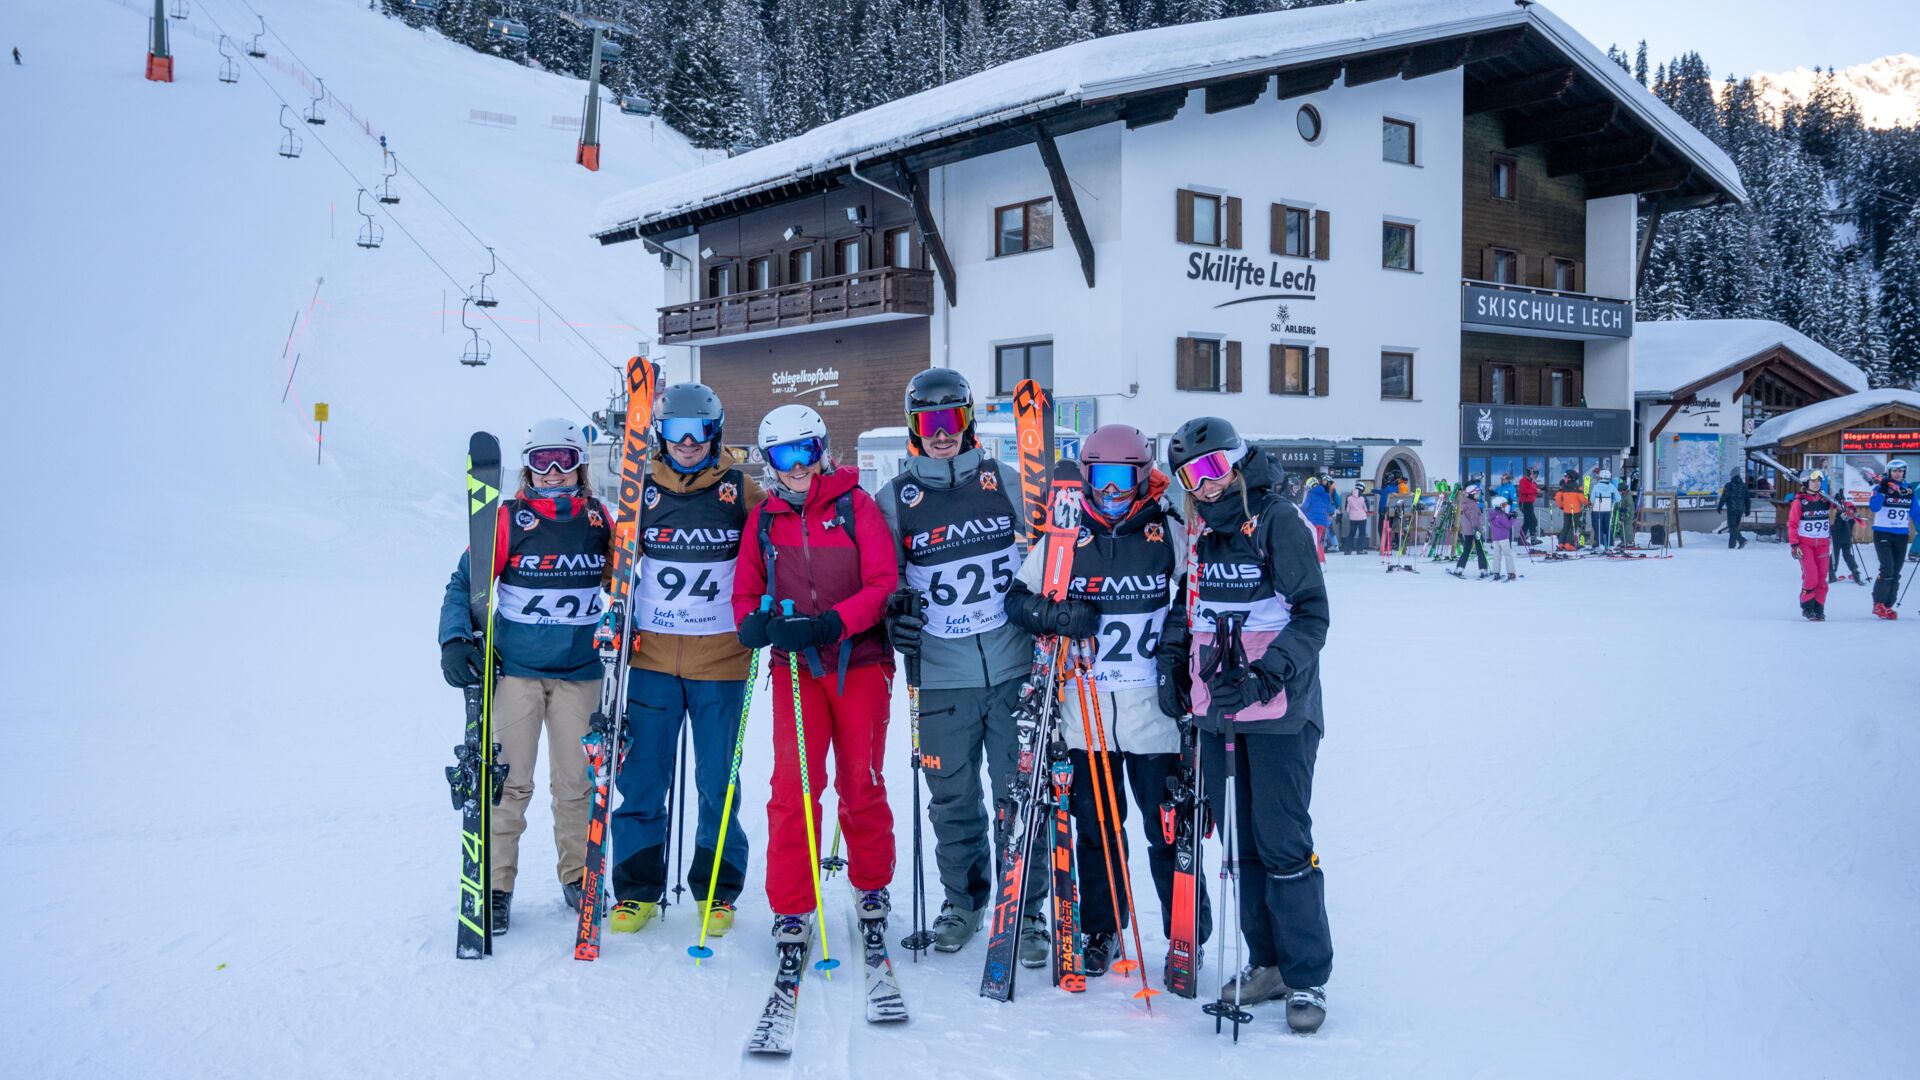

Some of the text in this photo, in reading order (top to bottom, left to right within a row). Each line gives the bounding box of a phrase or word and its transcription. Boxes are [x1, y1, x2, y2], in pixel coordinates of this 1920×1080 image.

[1187, 251, 1316, 292] Skilifte Lech
[1478, 295, 1622, 329] SKISCHULE LECH
[1271, 323, 1316, 335] SKI ARLBERG
[772, 367, 839, 386] Schlegelkopfbahn
[1504, 418, 1594, 428] SKI SNOWBOARD XCOUNTRY
[1504, 428, 1542, 436] INFO/TICKET
[1843, 432, 1870, 441] Sieger
[1871, 432, 1896, 440] feiern
[1282, 453, 1309, 461] KASSA
[1313, 453, 1318, 461] 2
[643, 528, 741, 545] REMUS
[912, 516, 1011, 550] REMUS
[963, 535, 985, 545] SPORT
[657, 566, 720, 602] 94
[929, 555, 1013, 607] 625
[1069, 574, 1166, 594] REMUS
[654, 608, 675, 619] Lech
[946, 614, 970, 625] Lech
[651, 616, 675, 628] Zürs
[945, 624, 971, 634] Zürs
[1093, 619, 1161, 663] 26
[581, 871, 599, 940] RACETIGER
[1062, 900, 1072, 971] RACETIGER
[1175, 940, 1189, 952] E14
